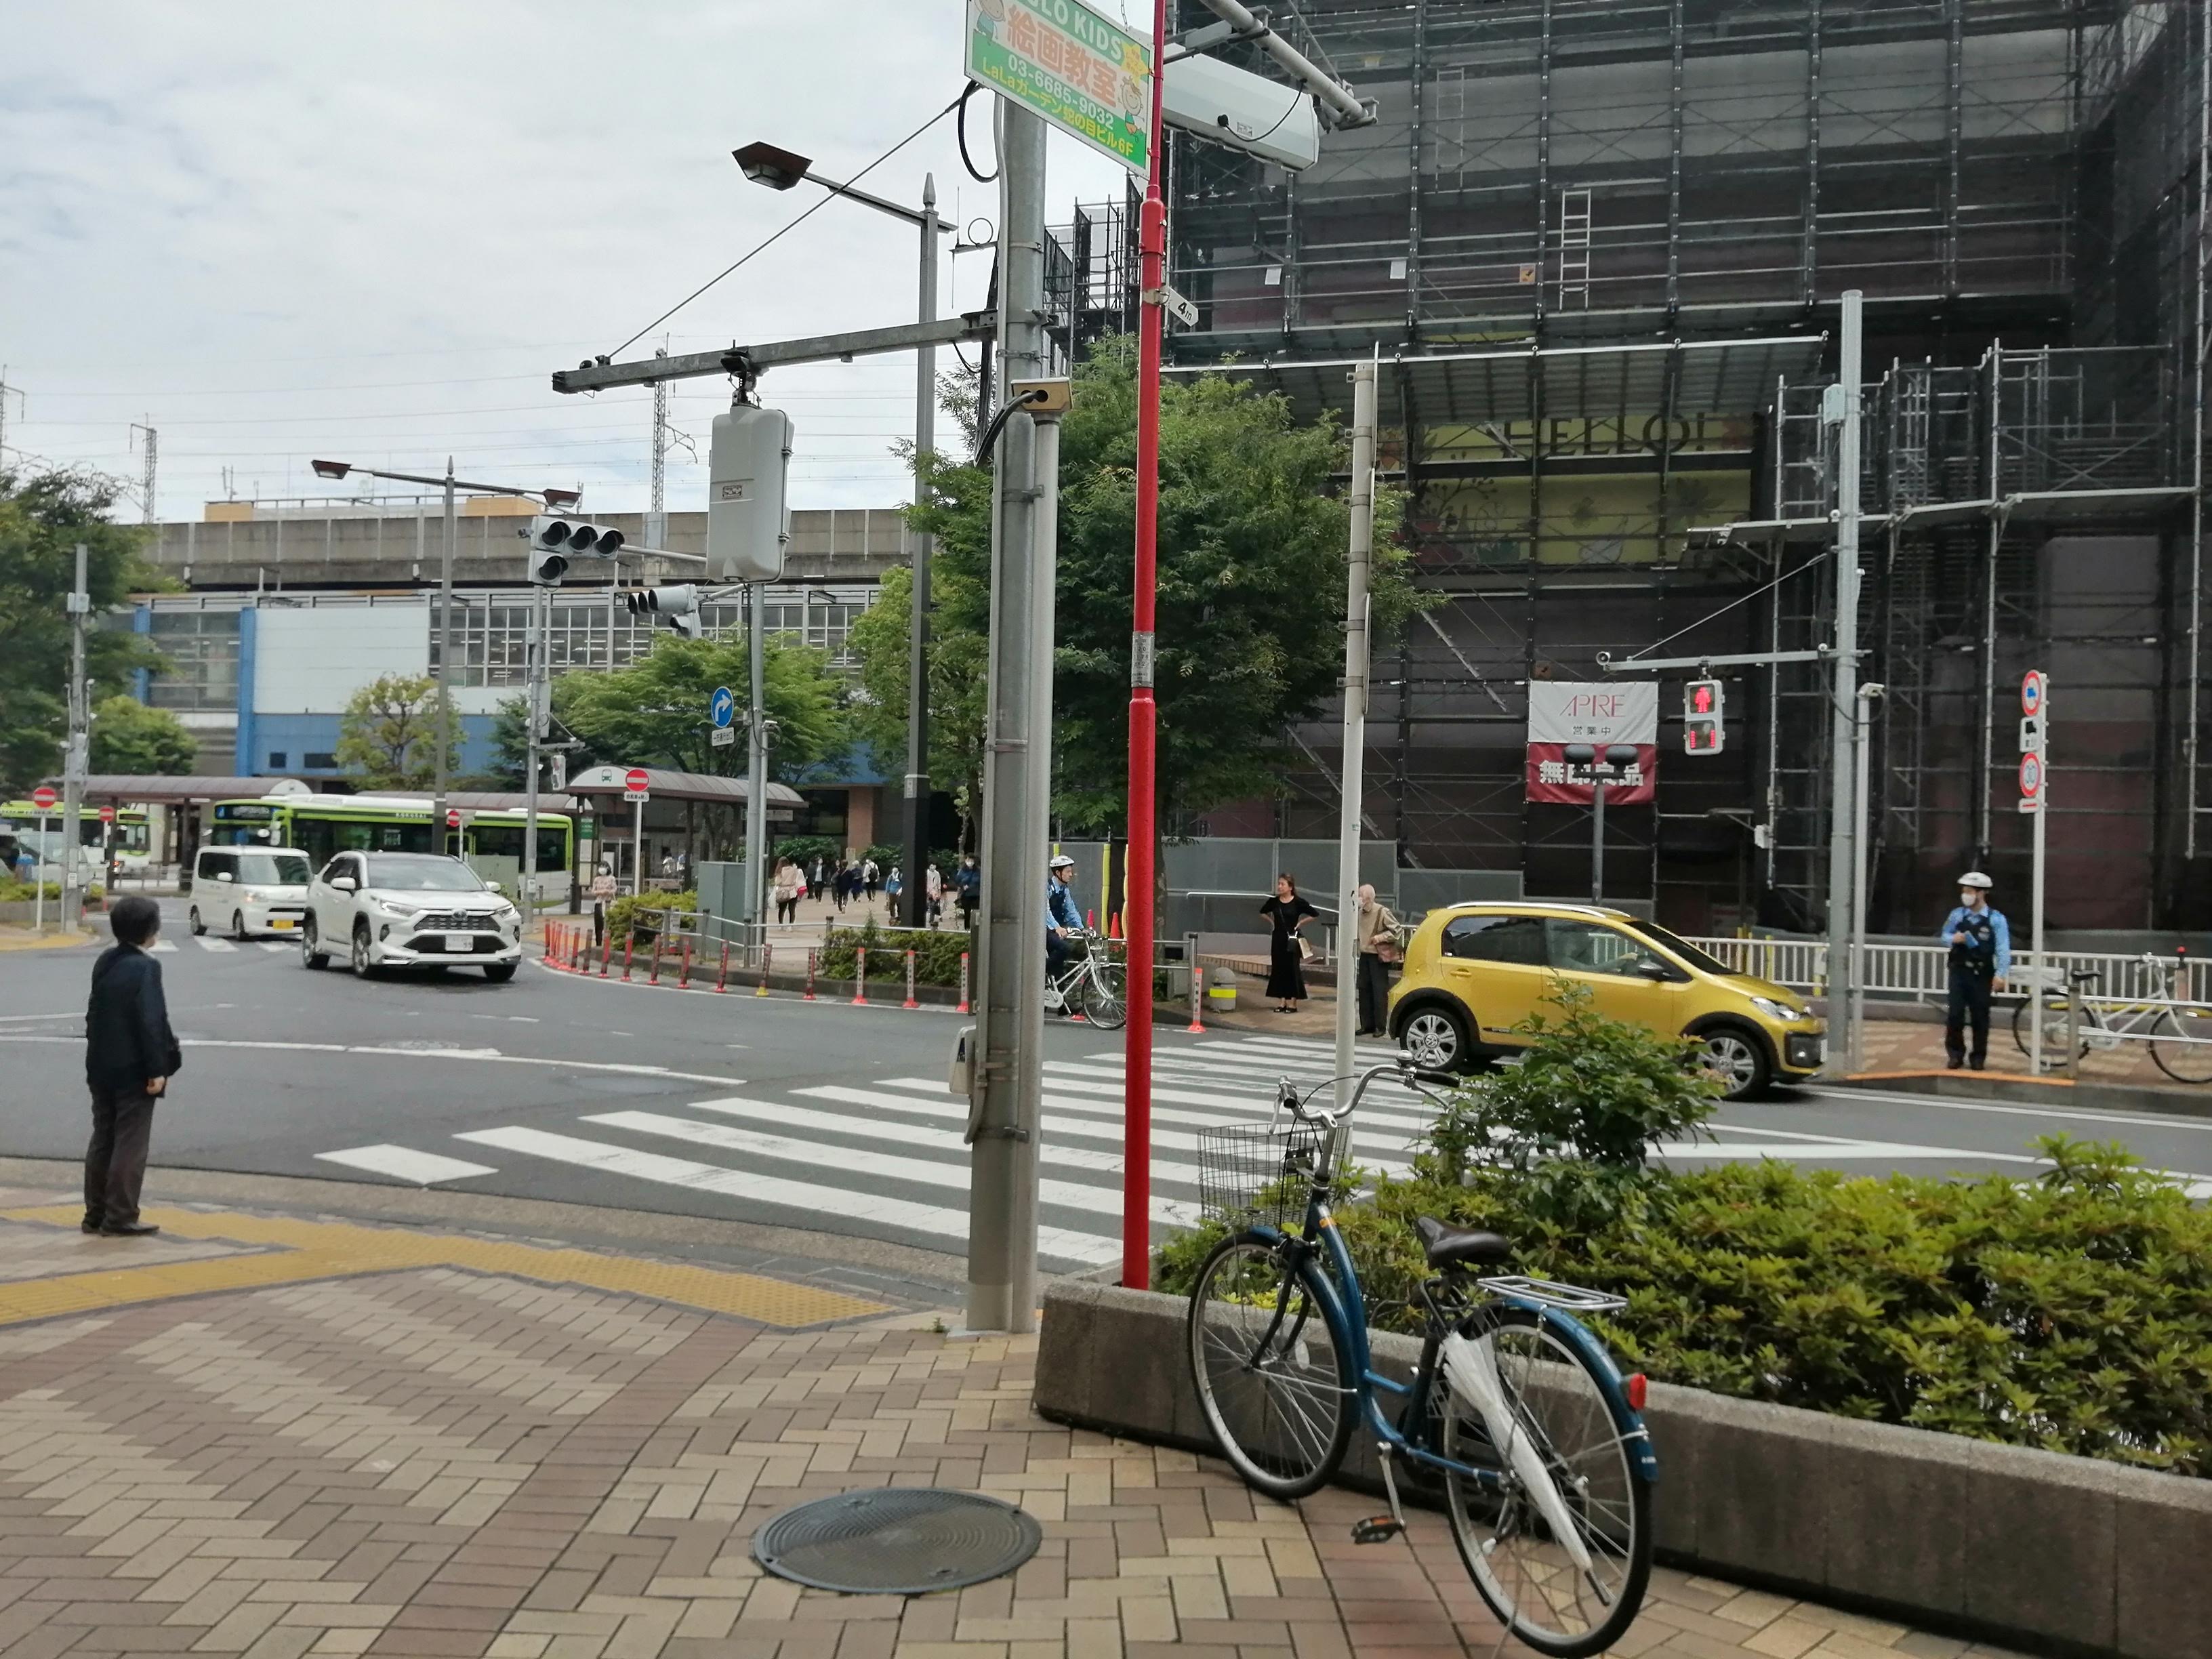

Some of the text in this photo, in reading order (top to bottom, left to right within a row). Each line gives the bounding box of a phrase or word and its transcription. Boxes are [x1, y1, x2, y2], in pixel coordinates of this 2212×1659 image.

[1006, 5, 1117, 108] 絵画教室
[1074, 10, 1122, 60] KIDS
[1008, 54, 1113, 129] 03-6685-9032
[1176, 302, 1193, 321] 4m
[1572, 726, 1611, 736] 営業中
